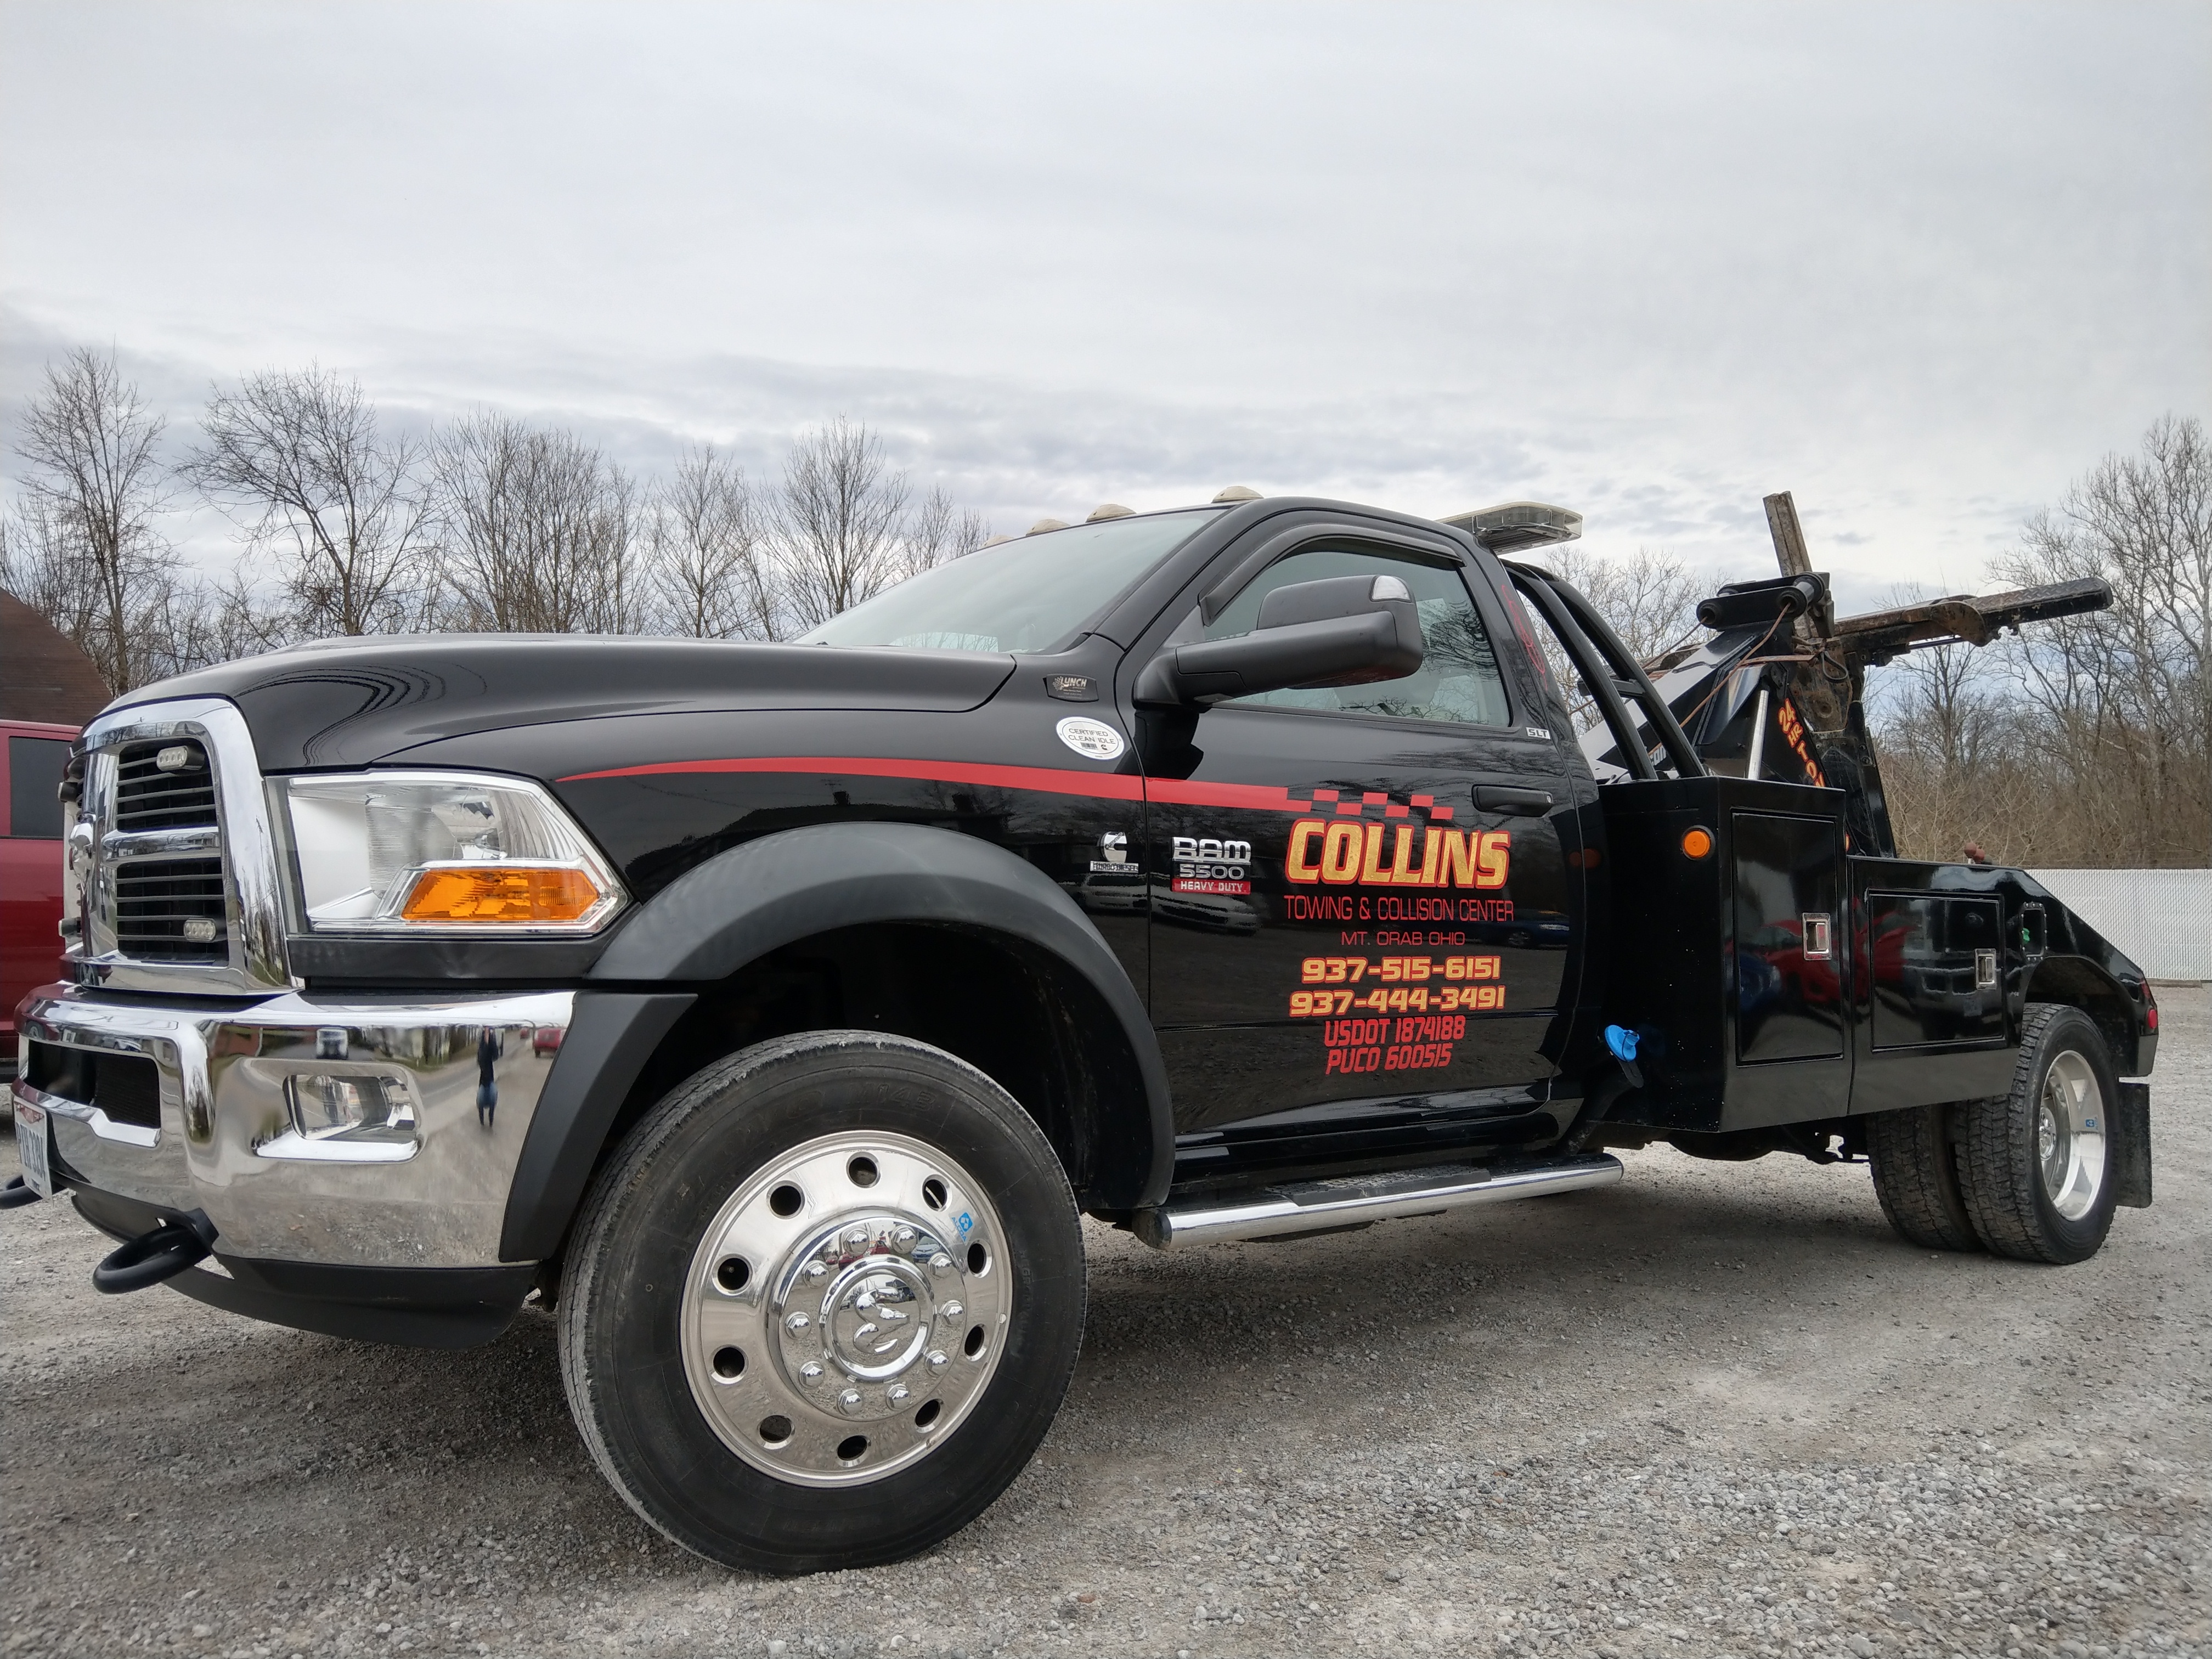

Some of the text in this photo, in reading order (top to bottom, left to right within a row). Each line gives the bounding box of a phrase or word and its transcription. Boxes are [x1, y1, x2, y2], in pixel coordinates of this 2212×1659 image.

[1060, 677, 1087, 687] LYNCH
[1778, 698, 1796, 733] 24
[1068, 728, 1108, 737] CERTIFIED
[1787, 721, 1803, 748] HR
[1104, 831, 1124, 850] Cummins
[1172, 837, 1251, 863] RAM
[1285, 818, 1510, 889] COLLINS
[1179, 864, 1245, 880] 5500
[1180, 880, 1244, 893] HEAVY DUTY
[1284, 895, 1514, 922] TOWING & COLLISION CENTER
[1340, 931, 1465, 946] MT. ORAB OHIO
[1302, 956, 1502, 984] 937-515-6151
[1289, 985, 1506, 1018] 937-444-3491
[1324, 1015, 1466, 1047] USDOT 1874188
[1325, 1043, 1454, 1075] PUCO 600515
[951, 1217, 967, 1242] ALCOA
